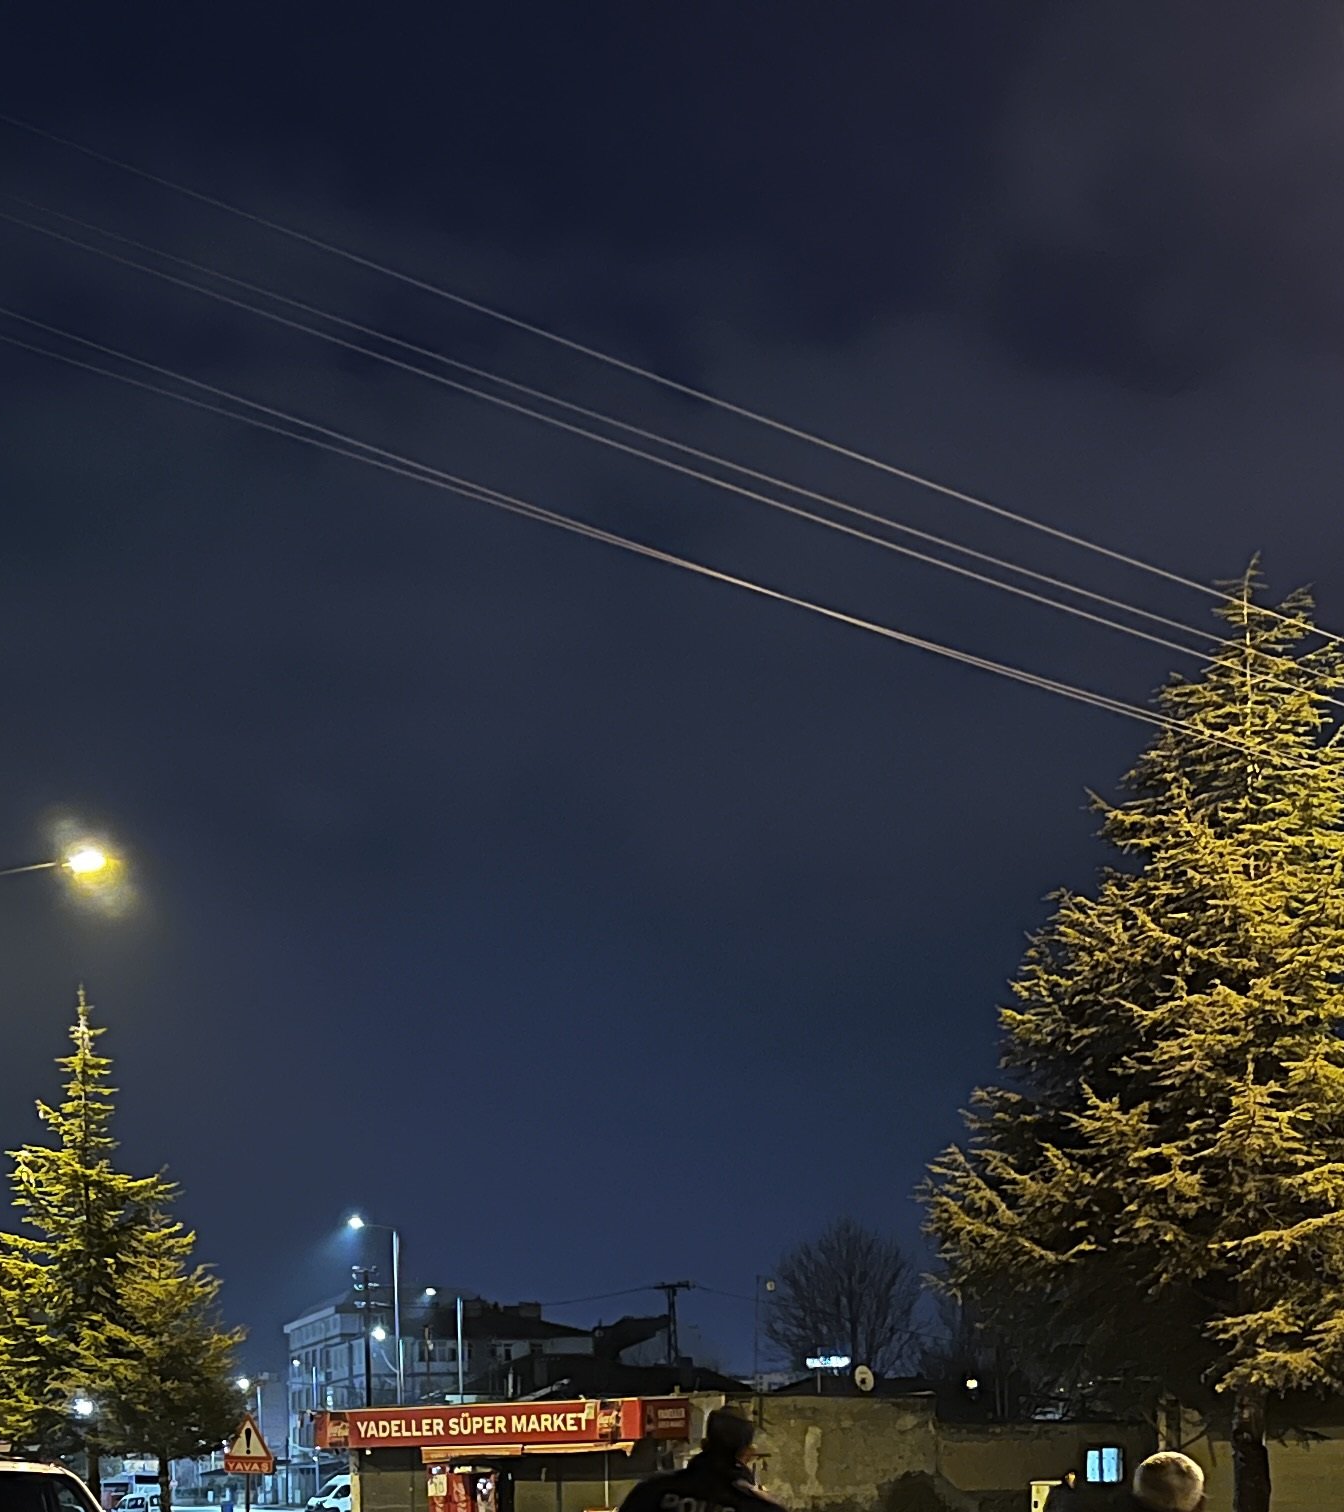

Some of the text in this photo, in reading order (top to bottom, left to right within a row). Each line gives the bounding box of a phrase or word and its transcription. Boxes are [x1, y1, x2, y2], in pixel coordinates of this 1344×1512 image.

[356, 1418, 445, 1438] YADELLER
[449, 1413, 507, 1435] SÜPER
[511, 1412, 587, 1432] MARKET
